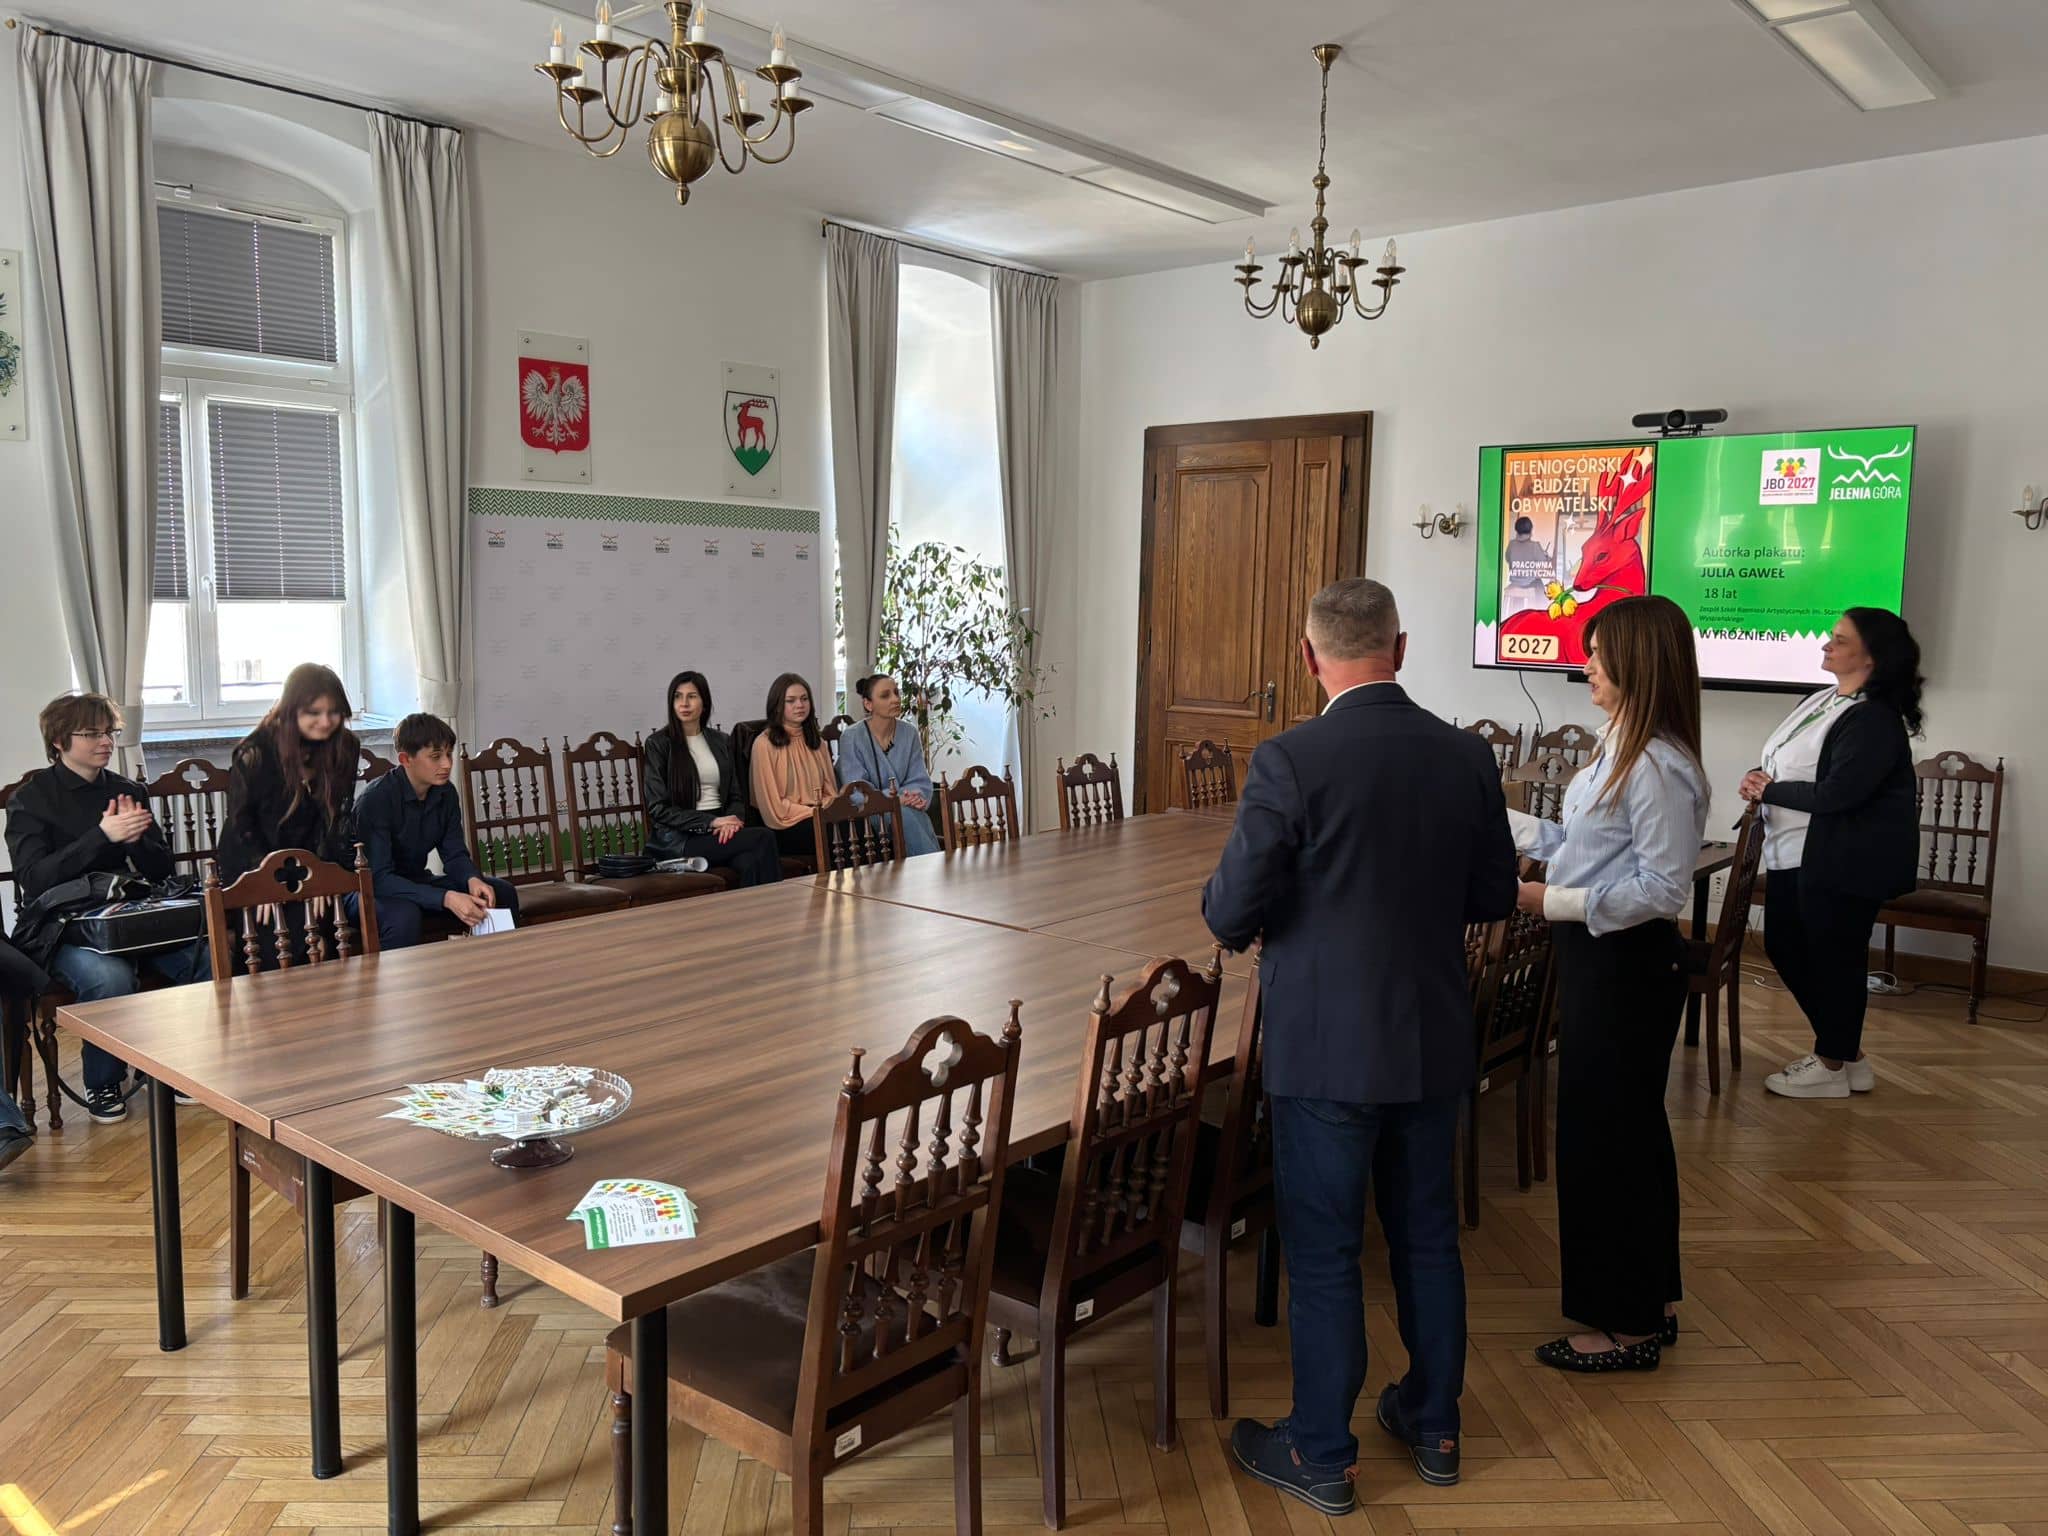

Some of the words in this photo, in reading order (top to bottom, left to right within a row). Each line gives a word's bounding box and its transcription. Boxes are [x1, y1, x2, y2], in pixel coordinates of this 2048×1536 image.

[1506, 456, 1621, 476] JELENIOGÓRSKI
[1533, 475, 1590, 494] BUDŻET
[1762, 478, 1785, 490] JBO
[1787, 477, 1815, 489] 2027
[1829, 487, 1871, 500] JELENIA
[1872, 483, 1901, 500] GÓRA
[1511, 496, 1613, 513] OBYWATELSKI
[1703, 546, 1750, 558] Autorka
[1754, 546, 1806, 560] plakatu:
[1511, 560, 1553, 570] PRACOWNIA
[1509, 568, 1556, 578] ARTYSTYCZNA
[1701, 567, 1735, 578] JULIA
[1739, 567, 1785, 579] GAWEŁ
[1704, 588, 1719, 599] 18
[1722, 587, 1737, 599] lat
[1699, 627, 1788, 642] WYRÓŻNIENIE
[1508, 637, 1552, 655] 2027
